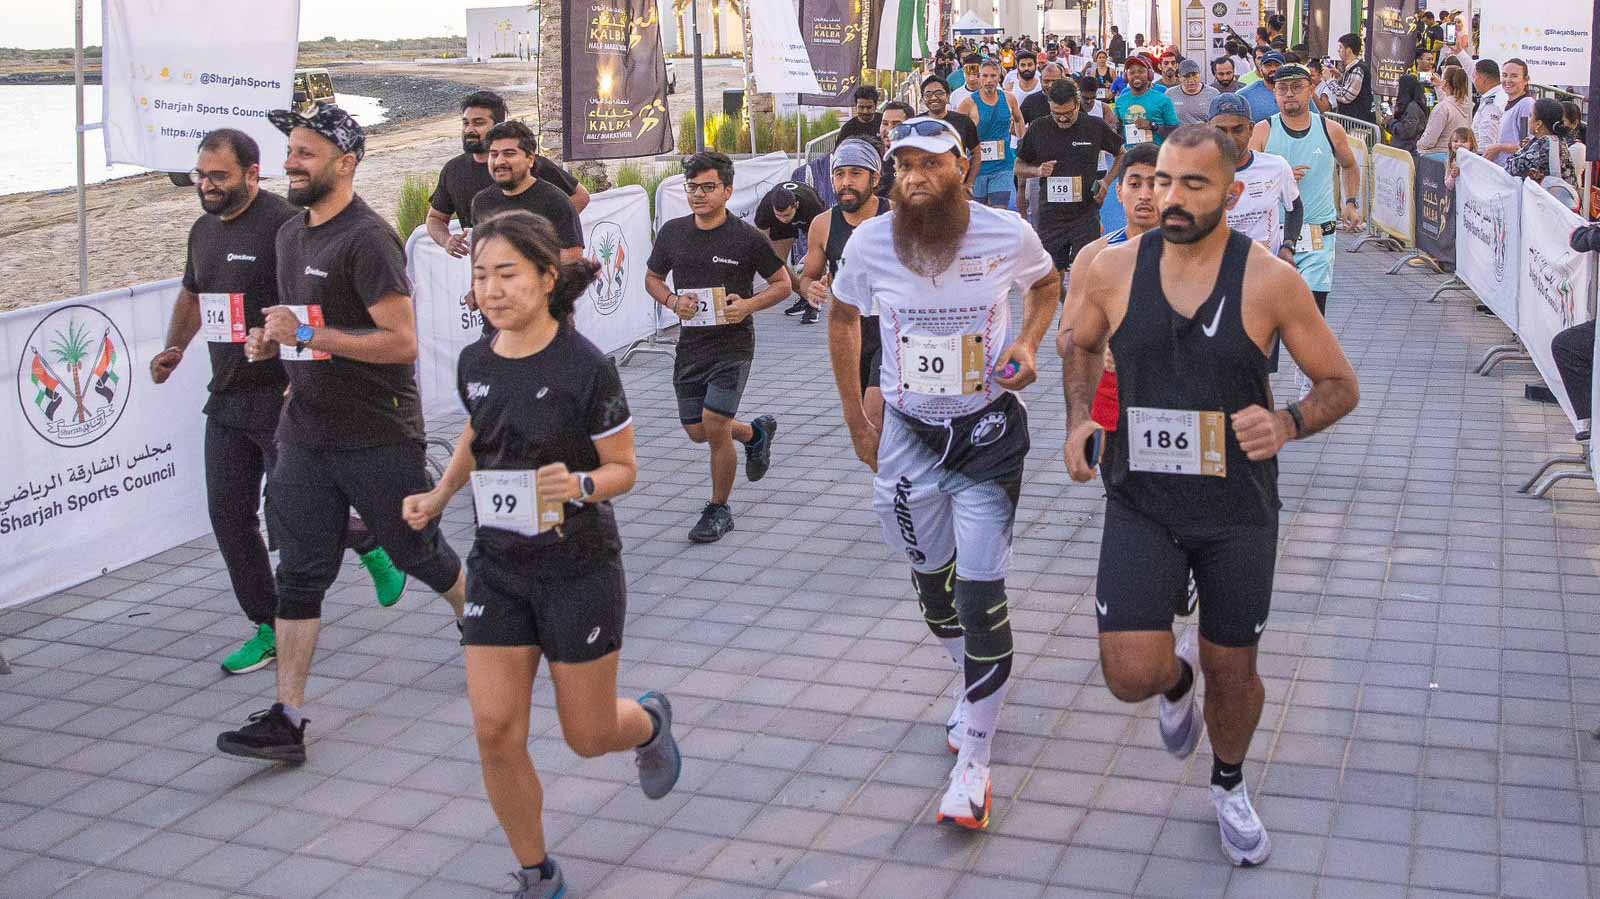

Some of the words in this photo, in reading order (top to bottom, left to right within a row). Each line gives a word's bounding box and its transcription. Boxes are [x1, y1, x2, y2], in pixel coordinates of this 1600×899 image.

[590, 28, 626, 41] KALBA
[814, 30, 840, 38] KALBA
[1544, 28, 1589, 37] @SharjahSports
[1521, 44, 1542, 52] Sharjah
[199, 73, 281, 89] @SharjahSports
[154, 99, 193, 113] Sharjah
[196, 104, 229, 115] Sports
[589, 119, 631, 131] KALBA
[160, 127, 209, 139] https://sh
[600, 131, 633, 140] MARATHON
[1052, 185, 1069, 193] 158
[207, 310, 225, 324] 514
[918, 355, 945, 374] 30
[1143, 430, 1189, 449] 186
[127, 442, 172, 469] مجلس
[66, 454, 121, 484] الشارقة
[0, 501, 63, 534] Sharjah
[67, 484, 120, 512] Sports
[123, 462, 176, 492] Council
[492, 494, 517, 514] 99
